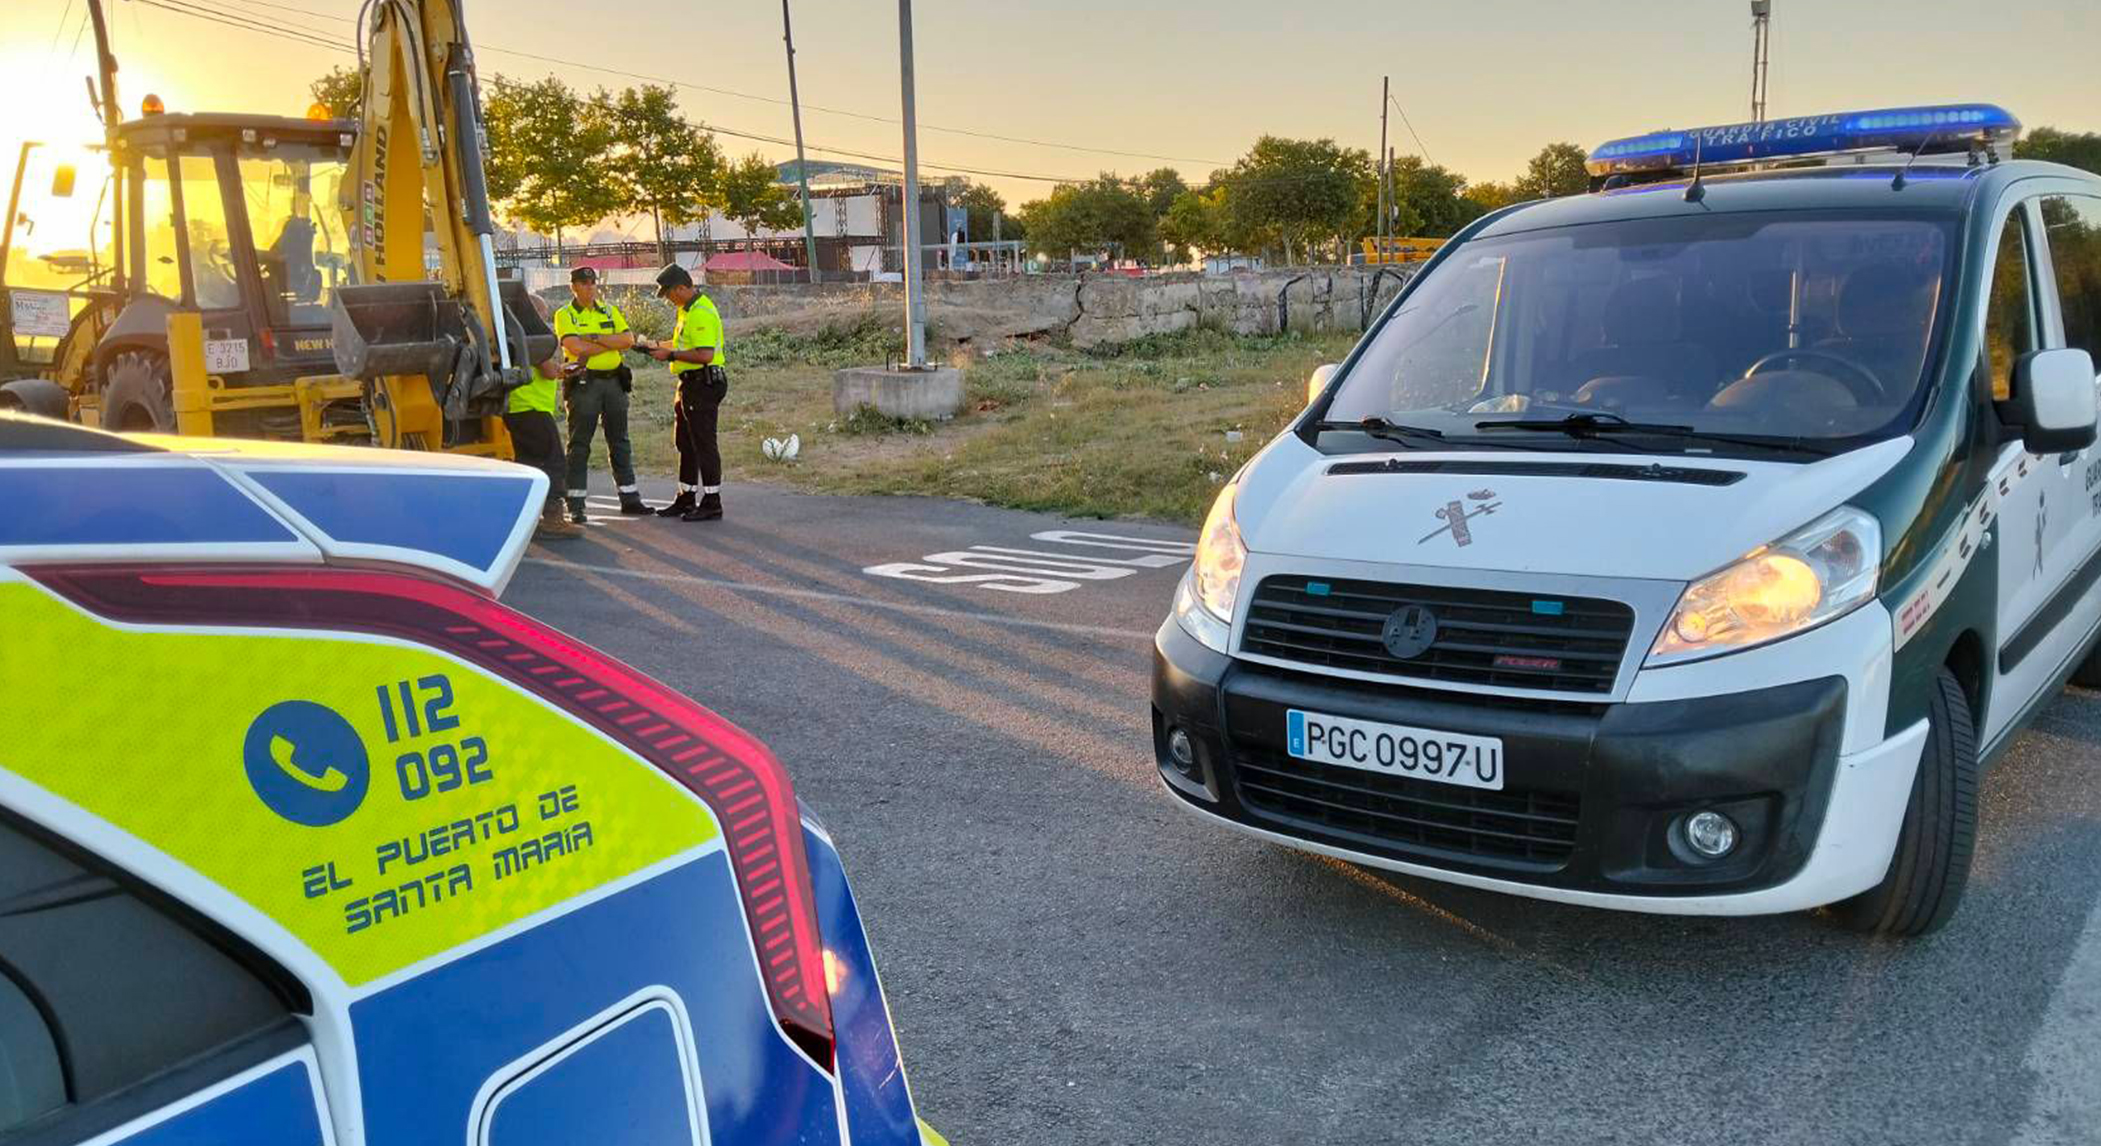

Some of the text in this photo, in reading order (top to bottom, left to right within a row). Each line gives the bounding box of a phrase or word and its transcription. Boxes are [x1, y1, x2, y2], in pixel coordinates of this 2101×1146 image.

[1688, 114, 1841, 139] GUARDIA CIVIL
[374, 125, 387, 265] HOLLAND
[376, 673, 460, 743] 112
[395, 736, 494, 801] 092
[302, 784, 580, 899] EL PUERTO DE
[344, 863, 473, 935] SANTA
